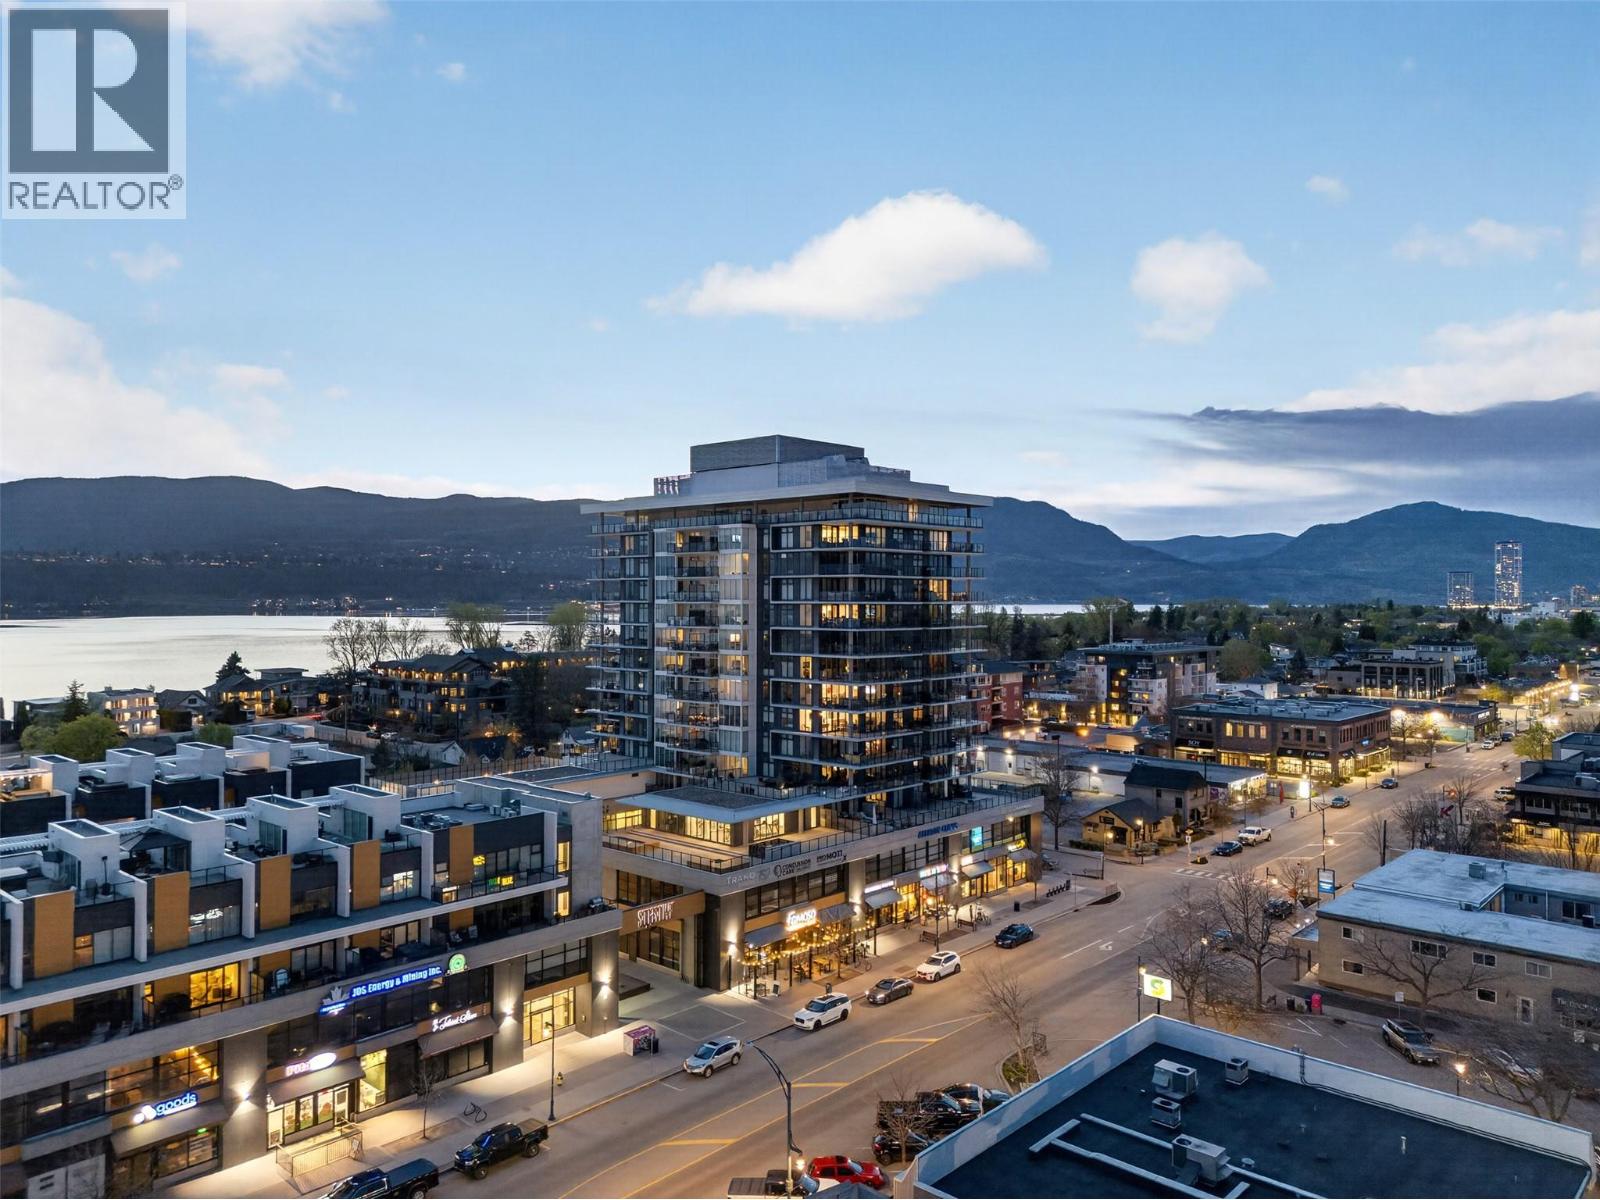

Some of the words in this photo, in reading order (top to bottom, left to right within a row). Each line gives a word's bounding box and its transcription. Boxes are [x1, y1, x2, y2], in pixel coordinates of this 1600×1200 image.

[352, 986, 367, 997] JDS
[368, 979, 395, 992] Energy
[402, 970, 428, 984] Mining
[428, 966, 442, 976] Inc.
[156, 1093, 196, 1114] goods
